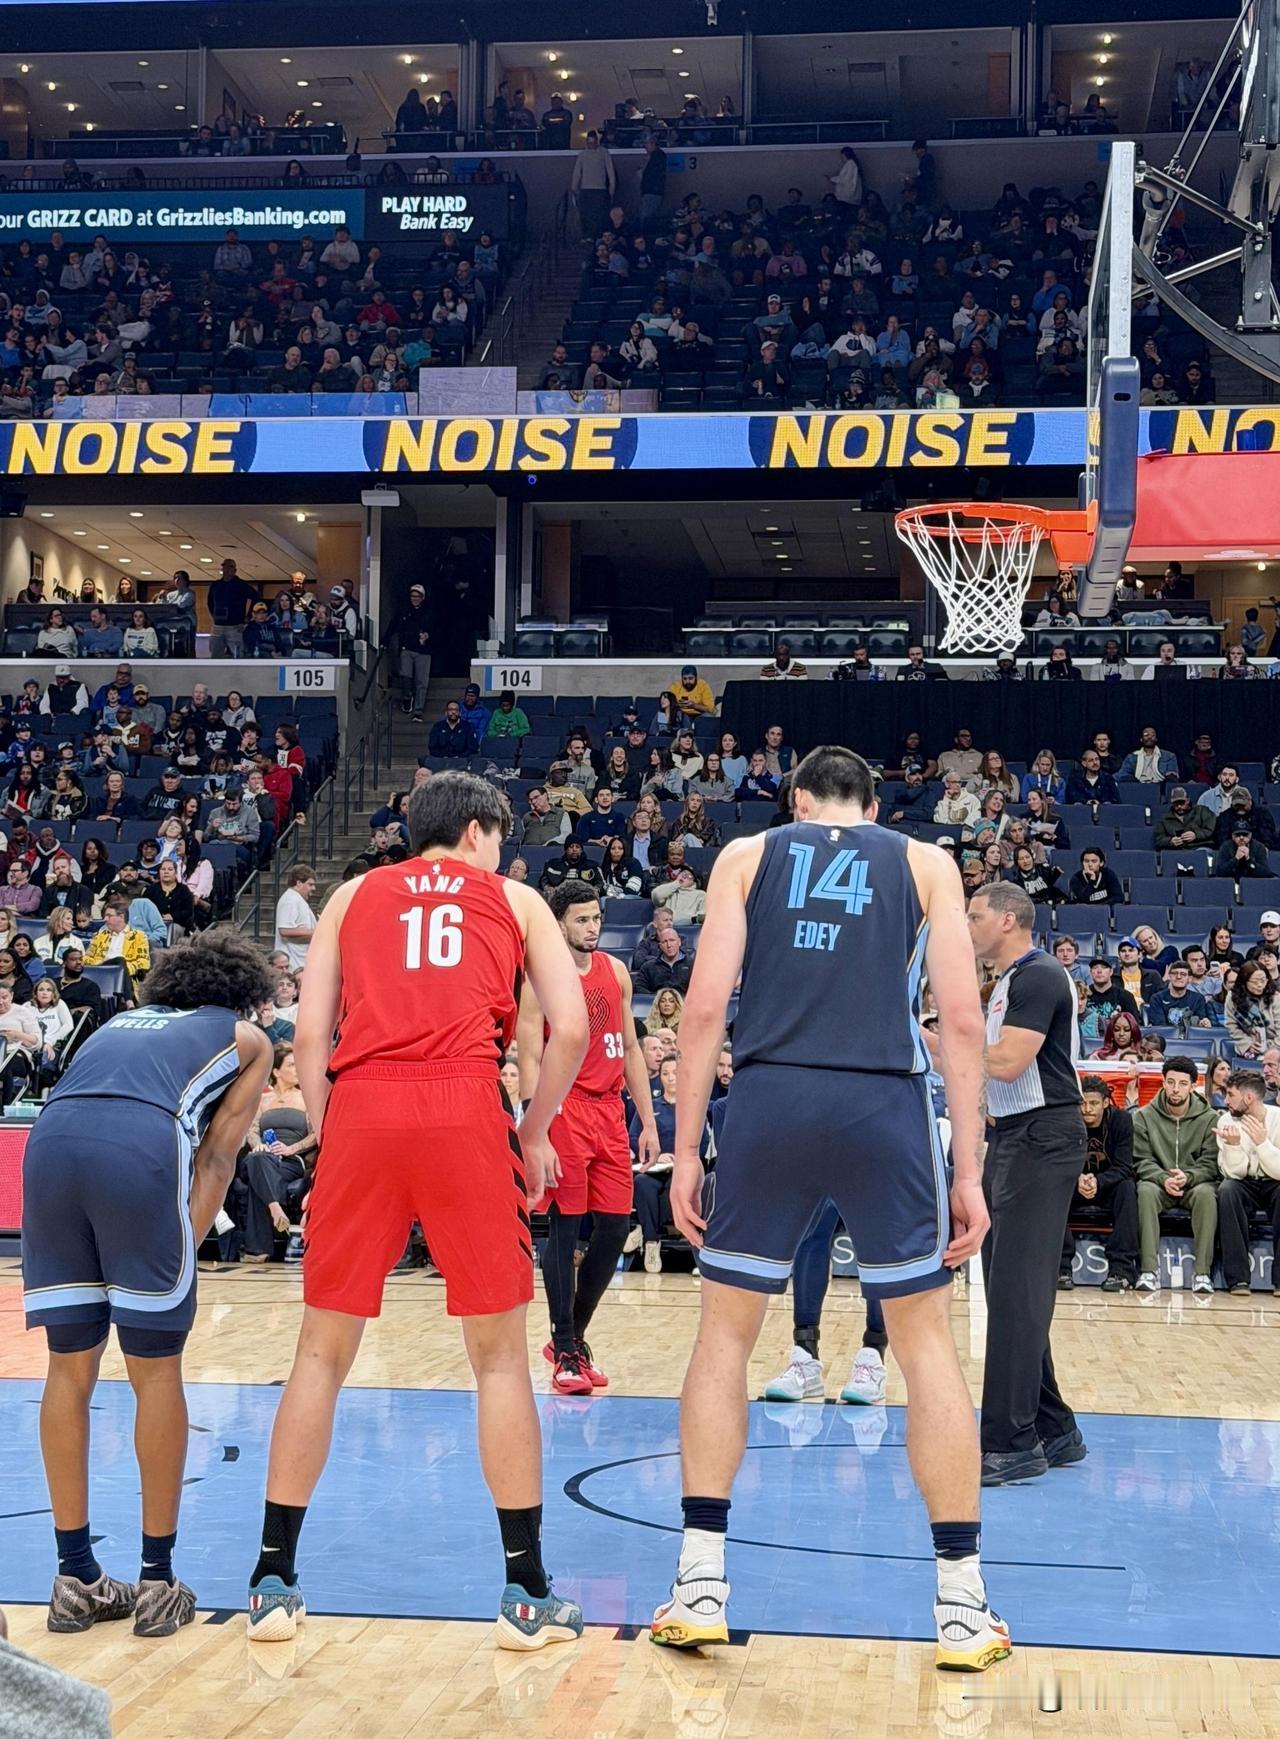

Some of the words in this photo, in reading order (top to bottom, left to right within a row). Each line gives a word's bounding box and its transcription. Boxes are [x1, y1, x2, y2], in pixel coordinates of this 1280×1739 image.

[382, 197, 420, 213] PLAY
[422, 196, 467, 212] HARD
[27, 210, 80, 228] GRIZZ
[84, 209, 133, 227] CARD
[136, 211, 153, 226] at
[156, 207, 346, 229] GrizzliesBanking.com
[400, 213, 437, 230] Bank
[439, 213, 474, 232] Easy
[7, 421, 241, 474] NOISE
[382, 417, 621, 472] NOISE
[769, 412, 1018, 468] NOISE
[293, 669, 324, 687] 105
[500, 669, 531, 687] 104
[404, 874, 465, 894] YANG
[787, 841, 874, 915] 14
[398, 903, 464, 970] 16
[793, 919, 842, 951] EDEY
[108, 1018, 169, 1030] WELLS
[603, 1031, 625, 1059] 33
